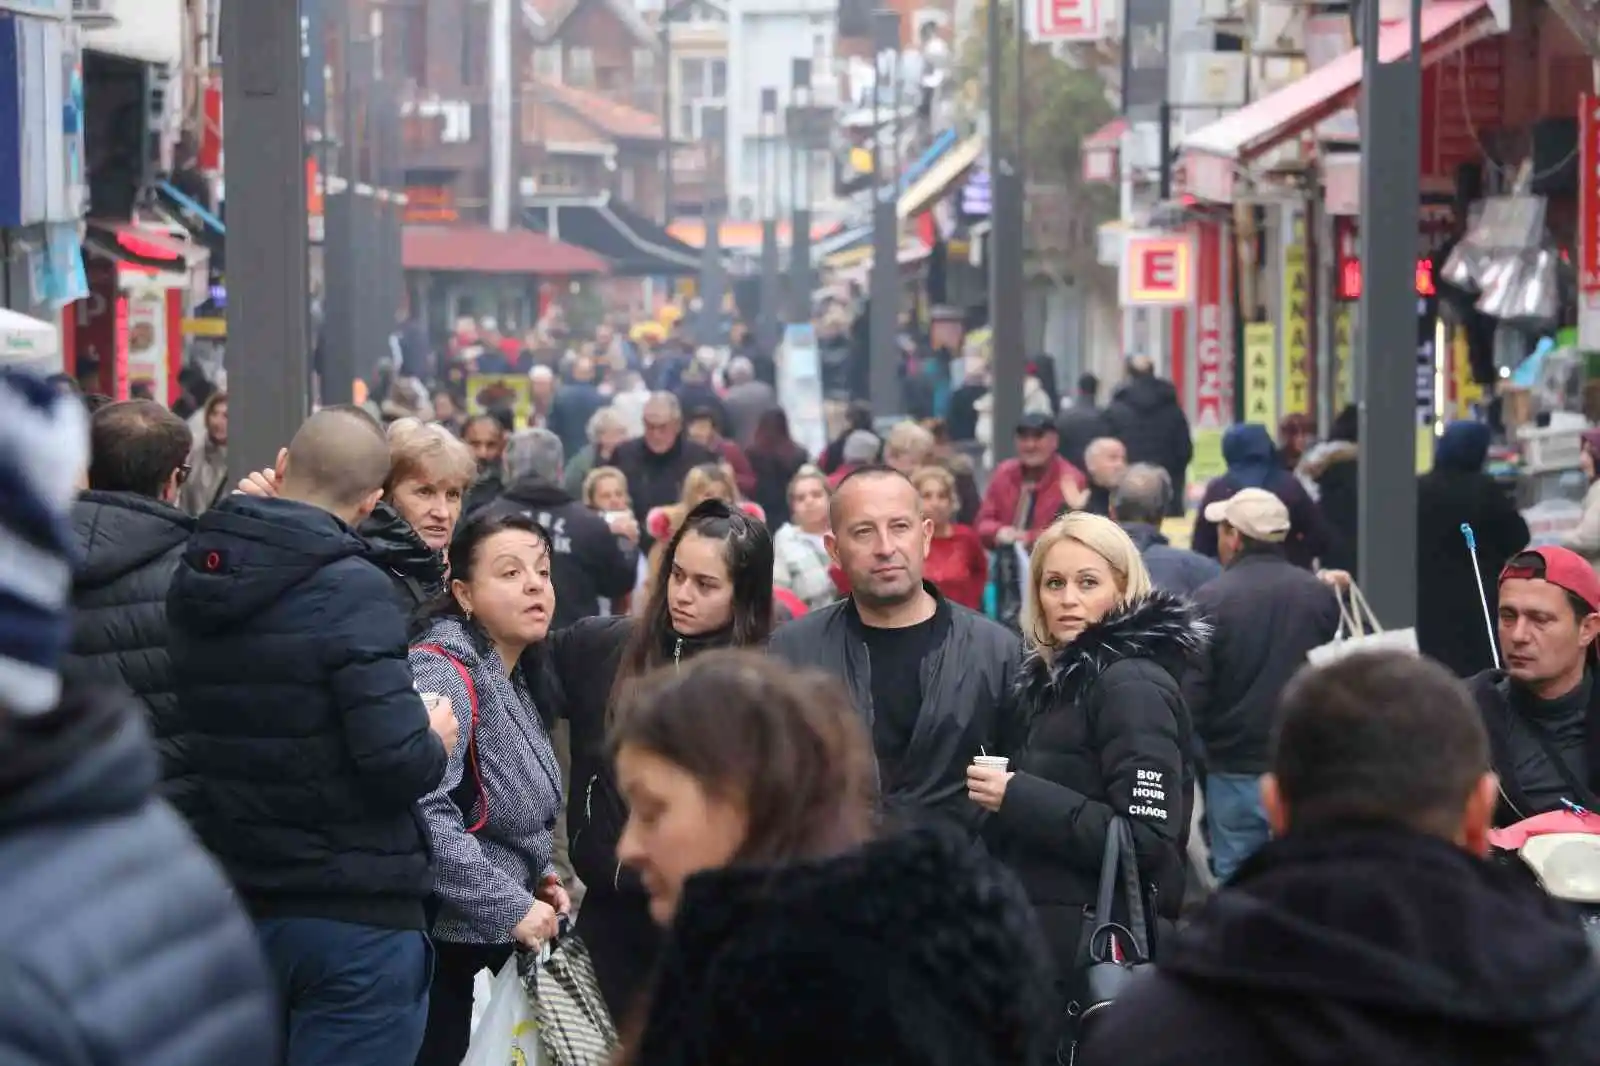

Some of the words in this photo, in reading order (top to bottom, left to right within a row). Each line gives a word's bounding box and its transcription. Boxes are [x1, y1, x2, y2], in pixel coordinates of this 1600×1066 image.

[1052, 0, 1081, 26] E
[1143, 250, 1176, 291] E
[1199, 304, 1221, 426] ECZA
[1137, 769, 1163, 781] BOY
[1132, 787, 1165, 800] HOUR
[1128, 804, 1168, 819] CHAOS
